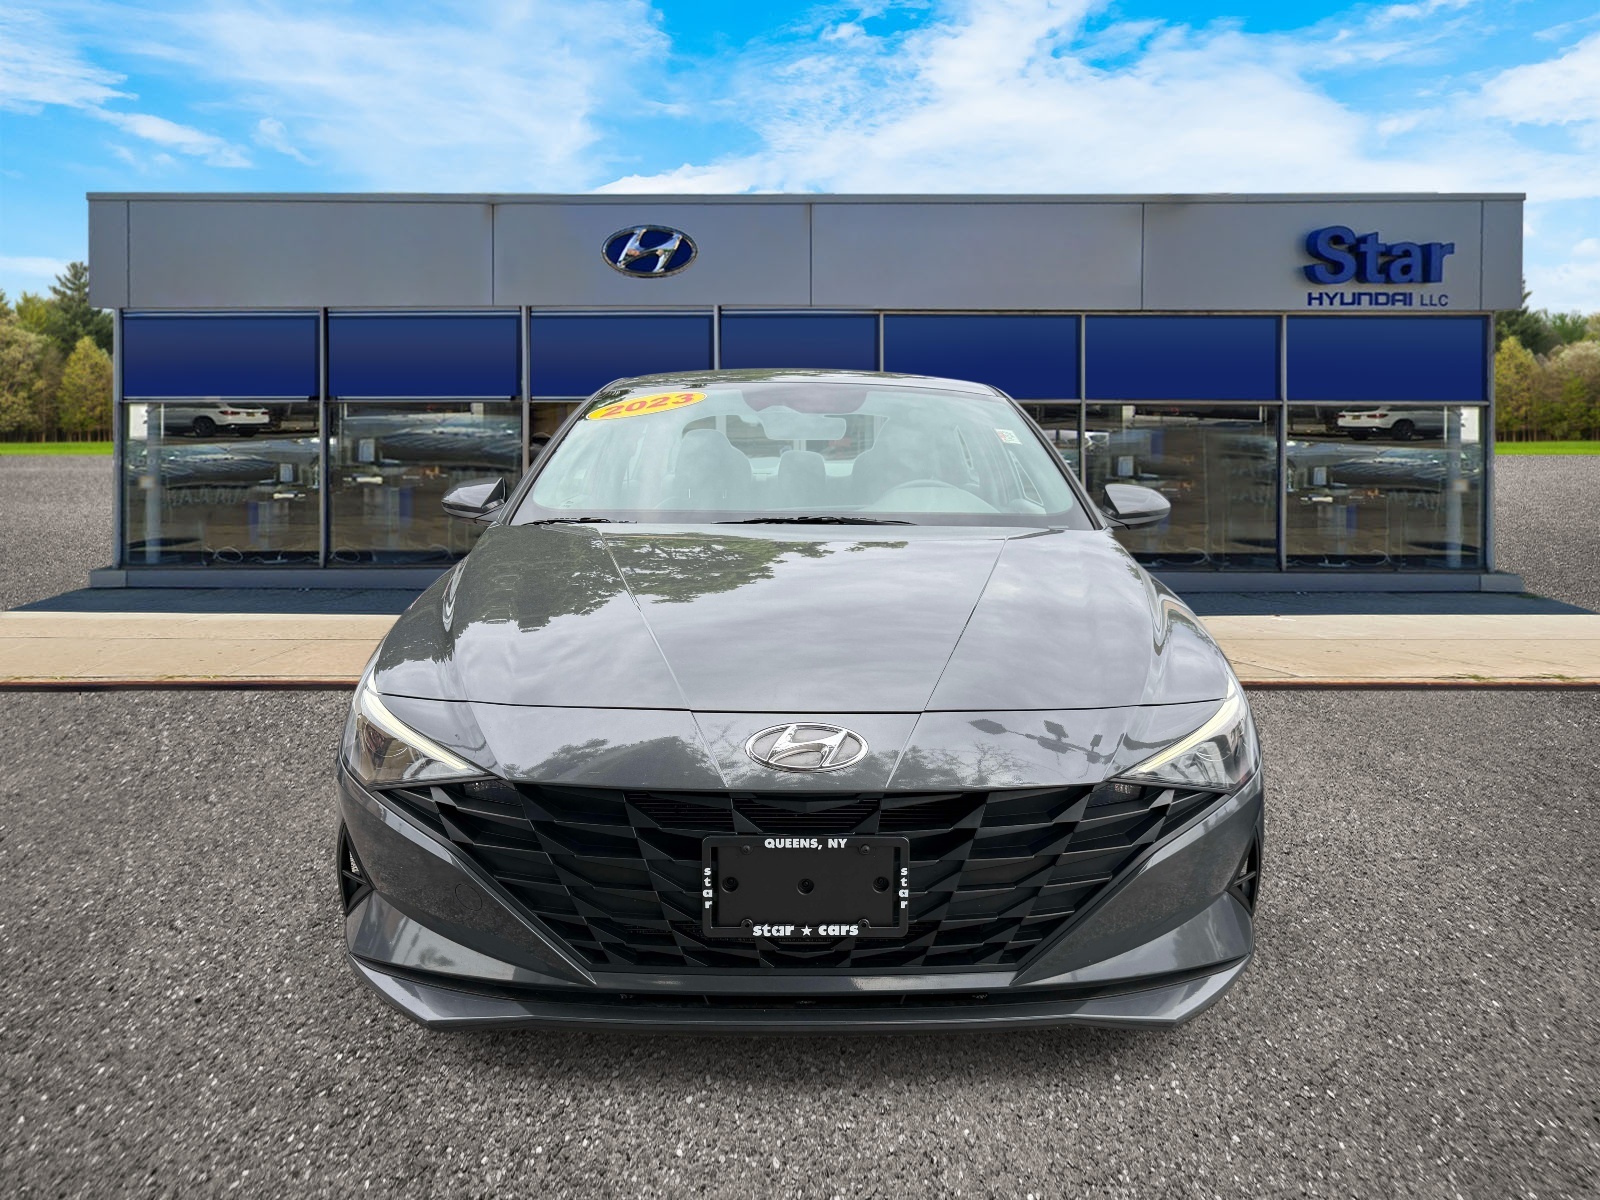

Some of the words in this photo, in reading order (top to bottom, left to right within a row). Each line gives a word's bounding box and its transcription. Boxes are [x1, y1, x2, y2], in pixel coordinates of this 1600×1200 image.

[1303, 225, 1455, 285] Star
[1307, 292, 1413, 306] HYUNDAI
[1419, 294, 1449, 307] LLC
[600, 393, 695, 418] 2023
[764, 838, 823, 850] QUEENS,
[827, 838, 848, 849] NY
[752, 923, 795, 937] star
[818, 924, 859, 936] cars
